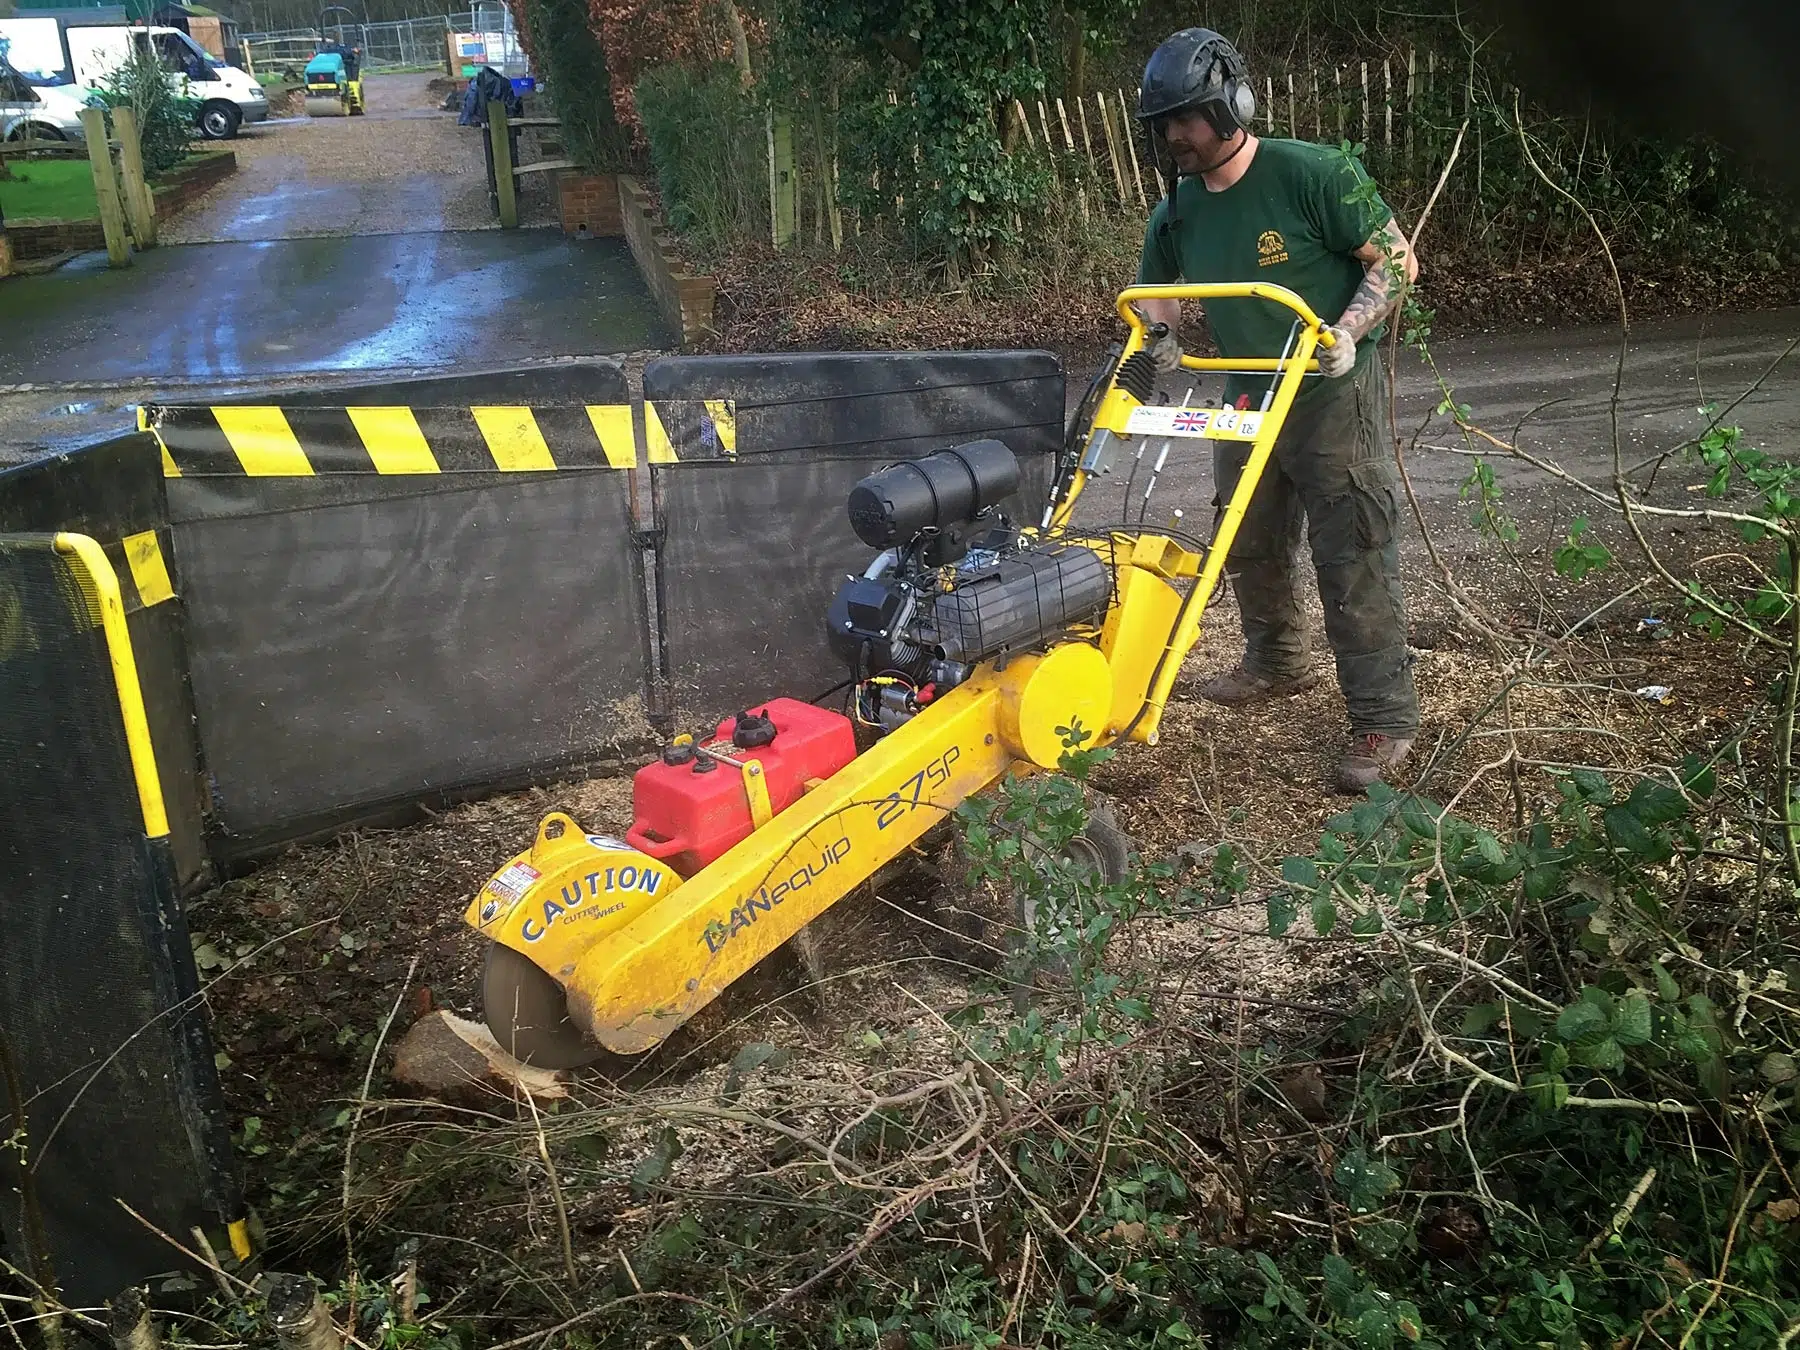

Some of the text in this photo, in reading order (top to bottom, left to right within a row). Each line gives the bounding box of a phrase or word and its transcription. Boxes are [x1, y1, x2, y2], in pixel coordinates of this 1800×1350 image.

[521, 866, 662, 942] CAUTION
[563, 902, 626, 925] CUTTER WHEEL
